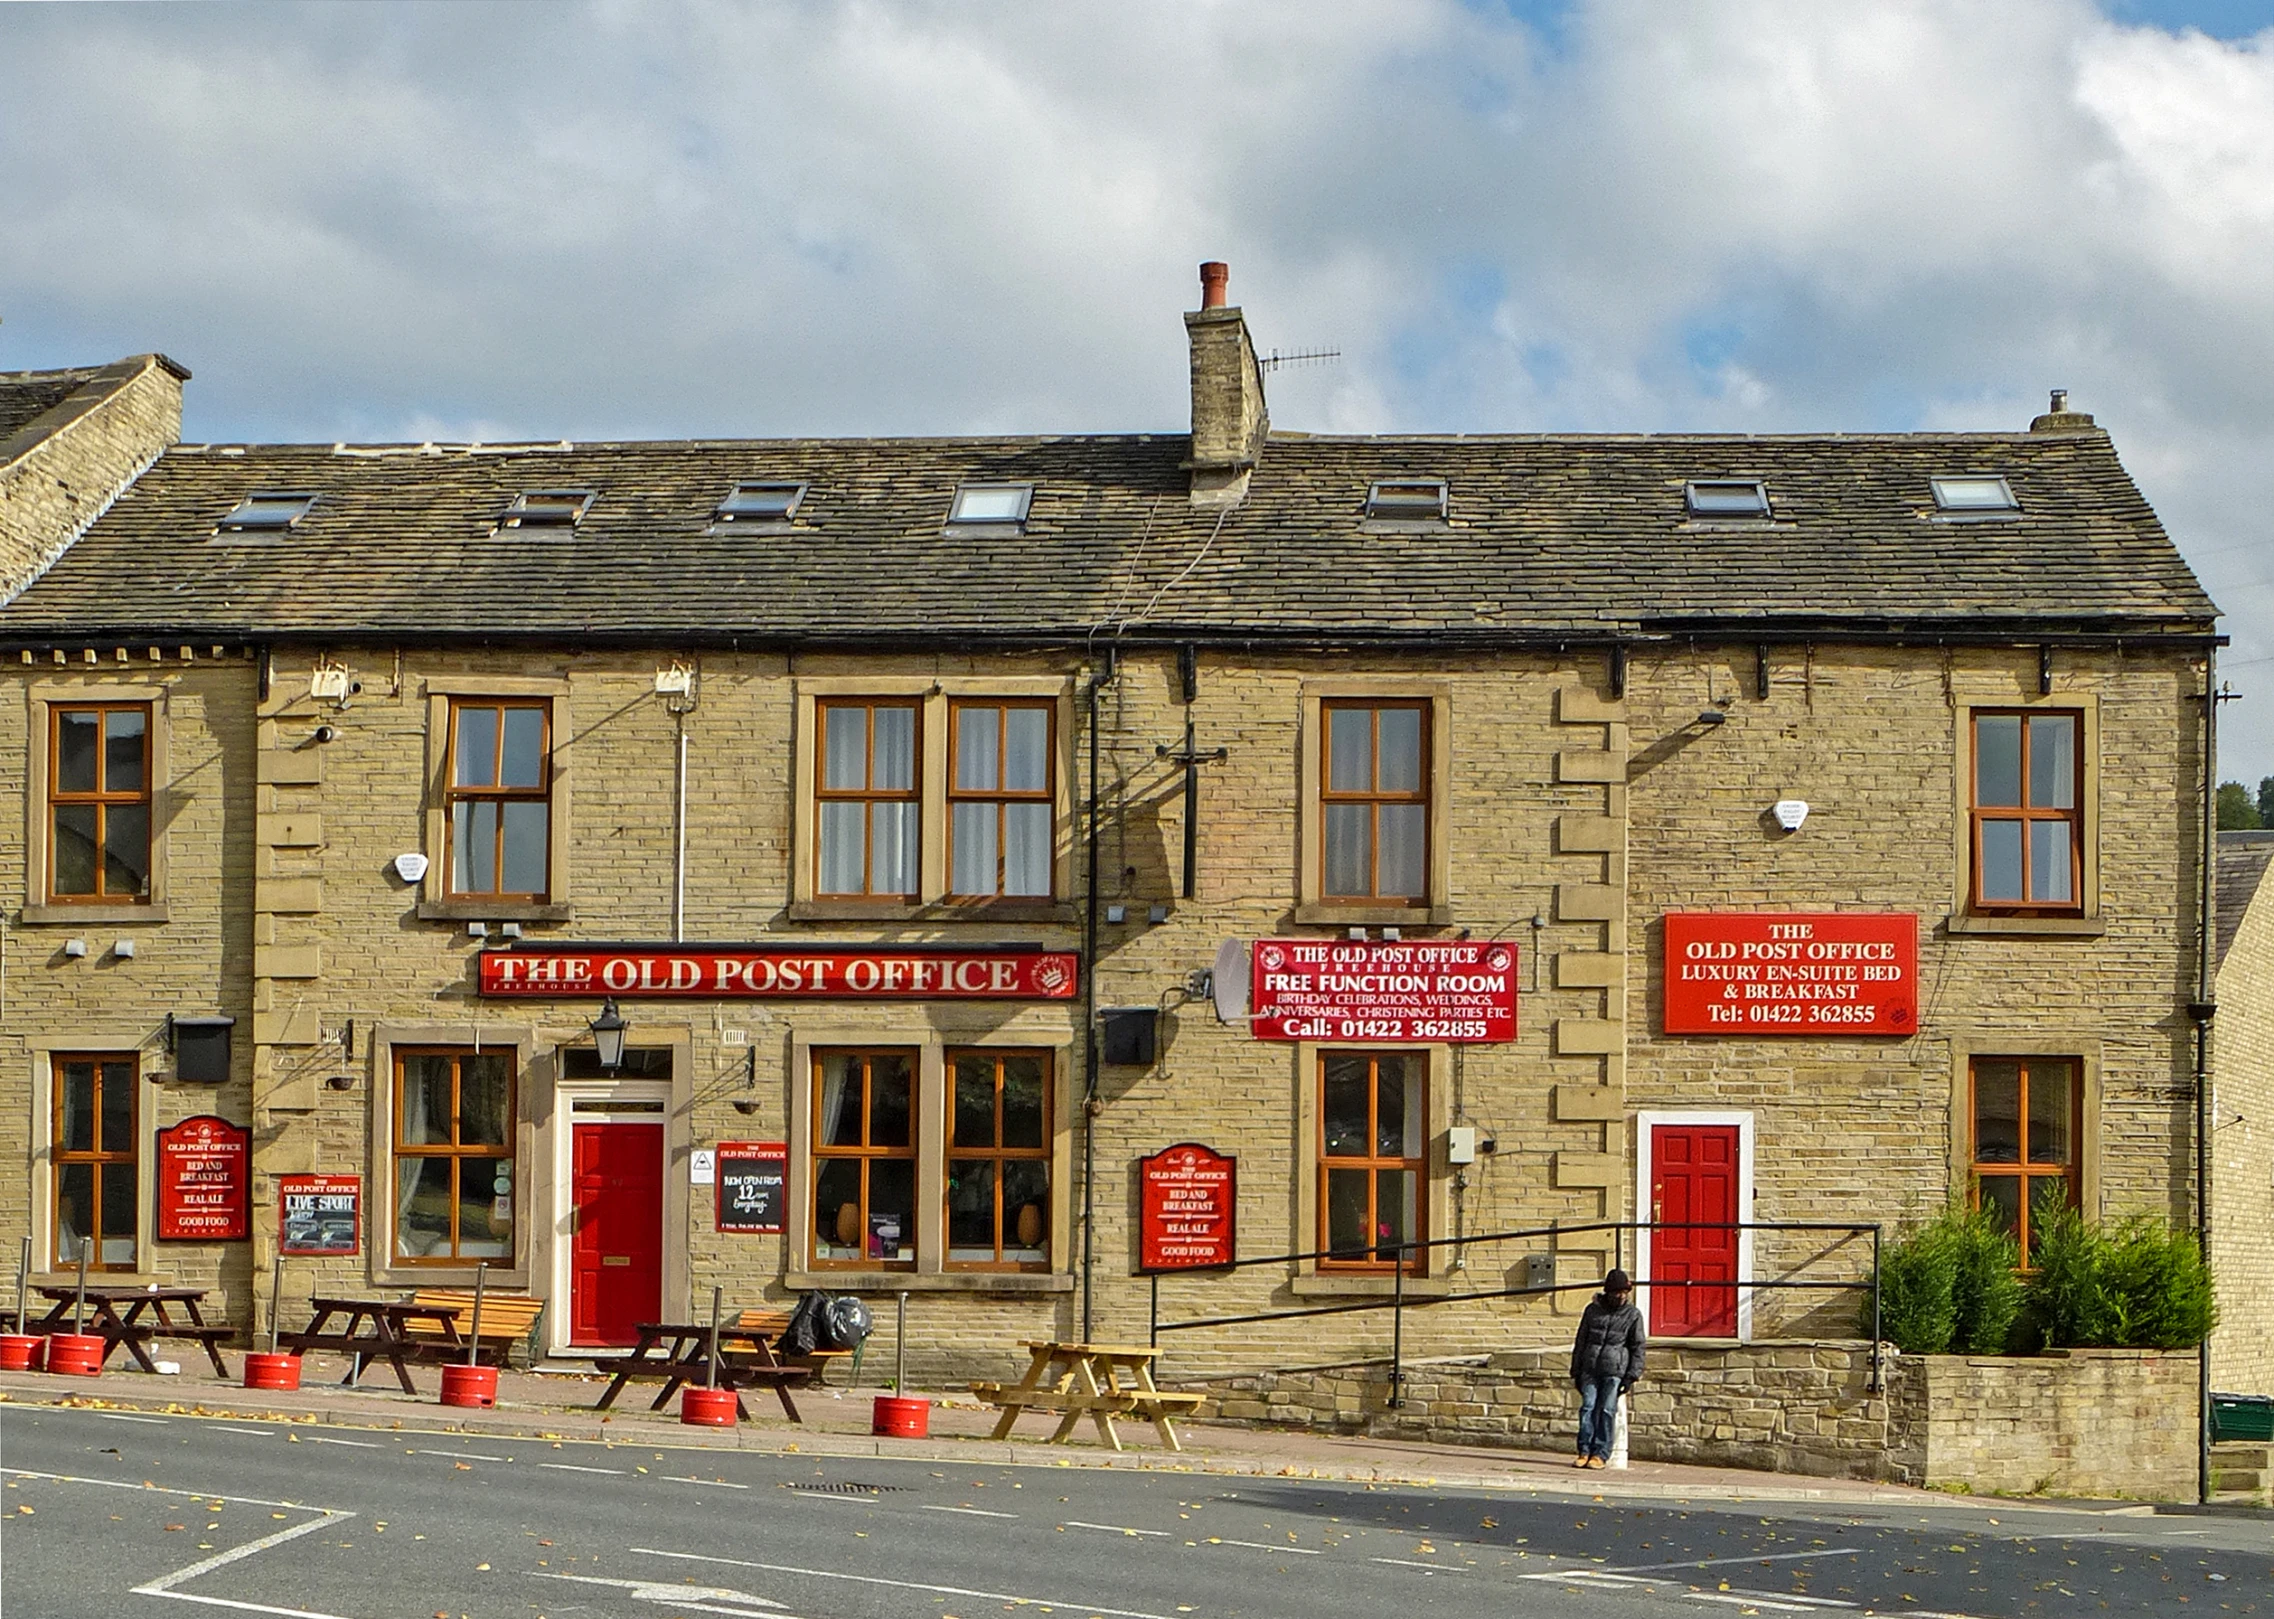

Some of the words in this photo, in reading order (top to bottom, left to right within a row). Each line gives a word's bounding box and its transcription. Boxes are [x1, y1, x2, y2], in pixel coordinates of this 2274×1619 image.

[1768, 924, 1814, 940] THE
[1293, 947, 1329, 963] THE
[1332, 947, 1367, 963] OLD
[1372, 947, 1414, 964] POST
[1418, 947, 1478, 964] OFFICE
[1686, 943, 1736, 960] OLD
[1741, 943, 1803, 960] POST
[1807, 943, 1895, 960] OFFICE
[494, 959, 592, 982] THE
[602, 959, 702, 990] OLD
[713, 959, 834, 991] POST
[845, 959, 1019, 991] OFFICE
[1681, 966, 1760, 981] LUXURY
[1766, 966, 1858, 981] EN-SUITE
[1863, 966, 1901, 981] BED
[1265, 974, 1312, 991] FREE
[1319, 975, 1429, 992] FUNCTION
[1436, 976, 1506, 993] ROOM
[1723, 984, 1739, 999] &
[1745, 984, 1859, 999] BREAKFAST
[1277, 993, 1333, 1005] BIRTHDAY
[1336, 994, 1422, 1006] CELEBRATIONS,
[1426, 995, 1494, 1006] WEDDINGS,
[1357, 1007, 1435, 1018] CHRISTENING
[1440, 1007, 1484, 1018] PARTIES
[1707, 1005, 1743, 1023] Tel:
[1750, 1005, 1802, 1023] 01422
[1808, 1005, 1876, 1023] 362855
[1283, 1018, 1333, 1036] Call:
[1341, 1020, 1402, 1037] 01422
[1411, 1021, 1487, 1038] 362855
[186, 1161, 204, 1171] BED
[205, 1161, 223, 1171] AND
[180, 1172, 229, 1182] BREAKFAST
[743, 1175, 763, 1186] OPEN
[283, 1185, 302, 1193] OLD
[303, 1185, 325, 1193] POST
[326, 1185, 359, 1193] OFFICE
[1169, 1190, 1188, 1199] BED
[1188, 1190, 1208, 1199] AND
[183, 1194, 206, 1204] REAL
[206, 1194, 224, 1204] ALE
[285, 1195, 315, 1210] LIVE
[318, 1195, 355, 1210] SPORT
[1162, 1201, 1215, 1211] BREAKFAST
[179, 1216, 204, 1226] GOOD
[205, 1216, 229, 1226] FOOD
[1166, 1223, 1190, 1234] REAL
[1191, 1223, 1209, 1234] ALE
[1161, 1246, 1188, 1256] GOOD
[1189, 1246, 1215, 1256] FOOD
